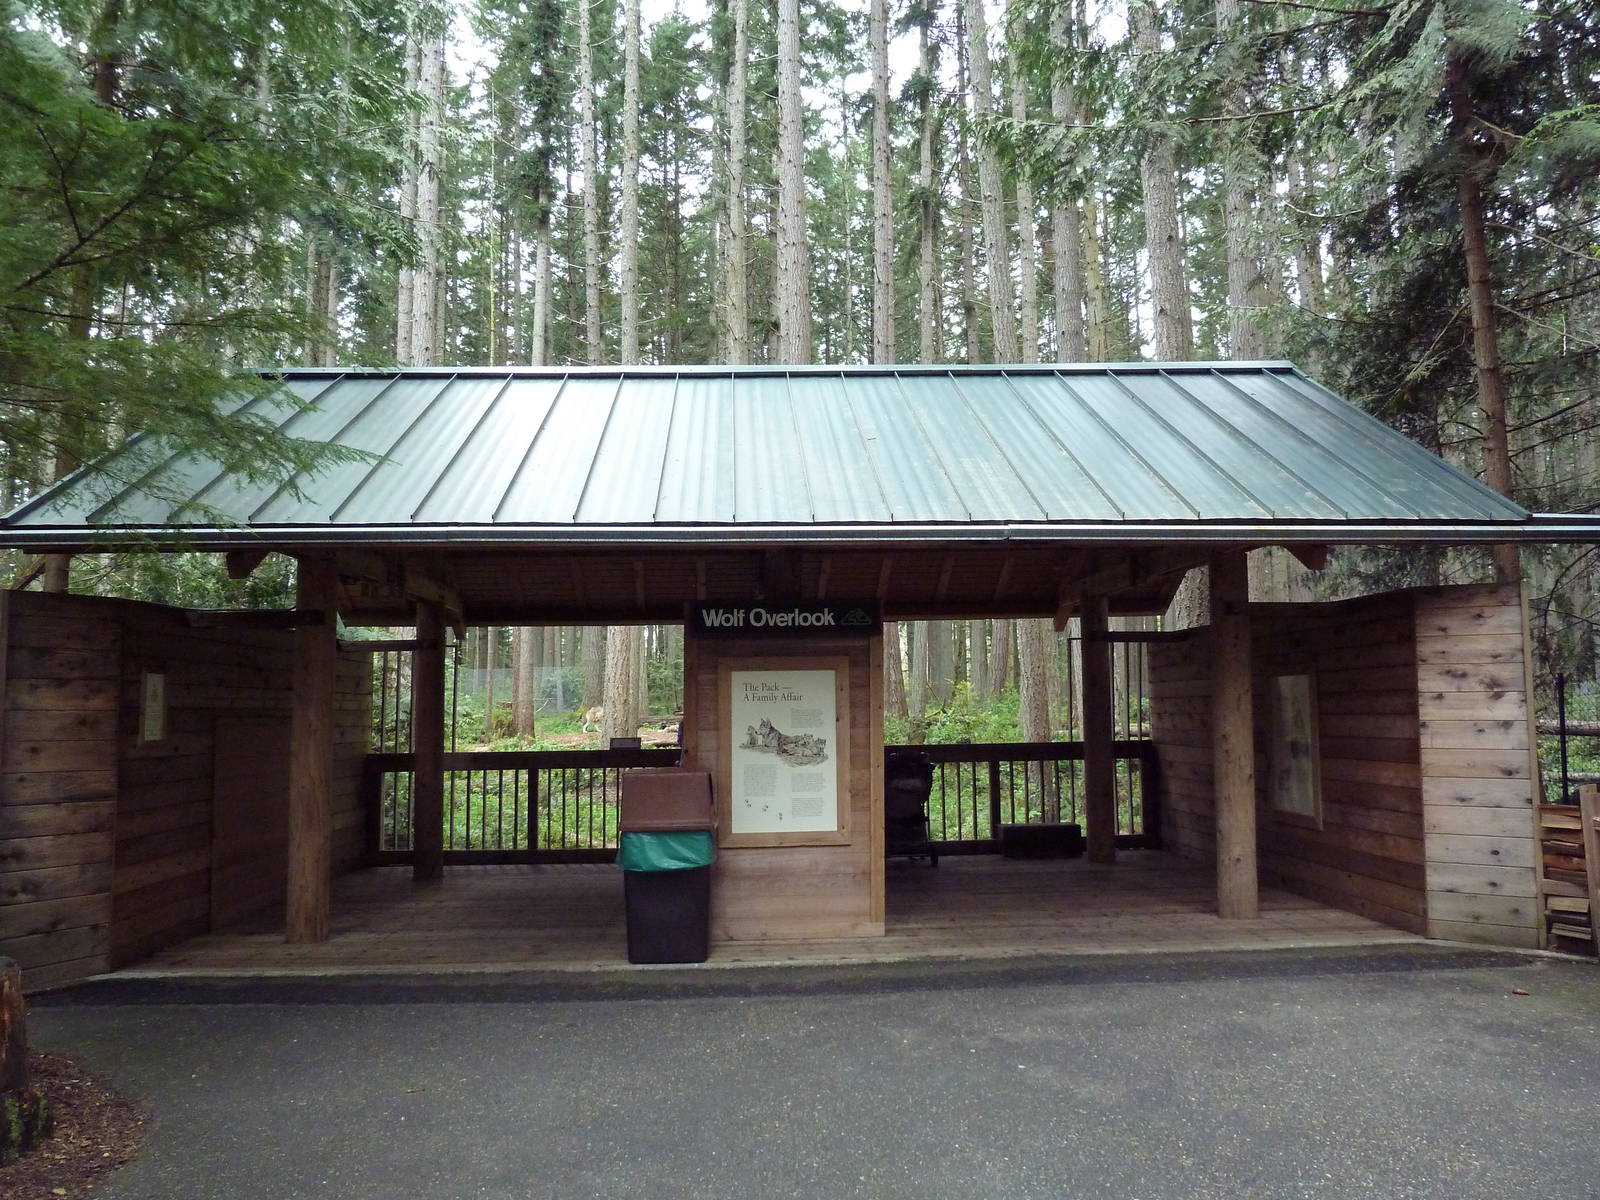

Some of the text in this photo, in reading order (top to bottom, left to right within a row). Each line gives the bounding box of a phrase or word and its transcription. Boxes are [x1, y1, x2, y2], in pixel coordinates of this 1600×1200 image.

[702, 607, 836, 627] Wolf Overlook
[743, 682, 759, 692] The
[761, 682, 780, 692] Pack
[743, 692, 803, 704] A Family Affair
